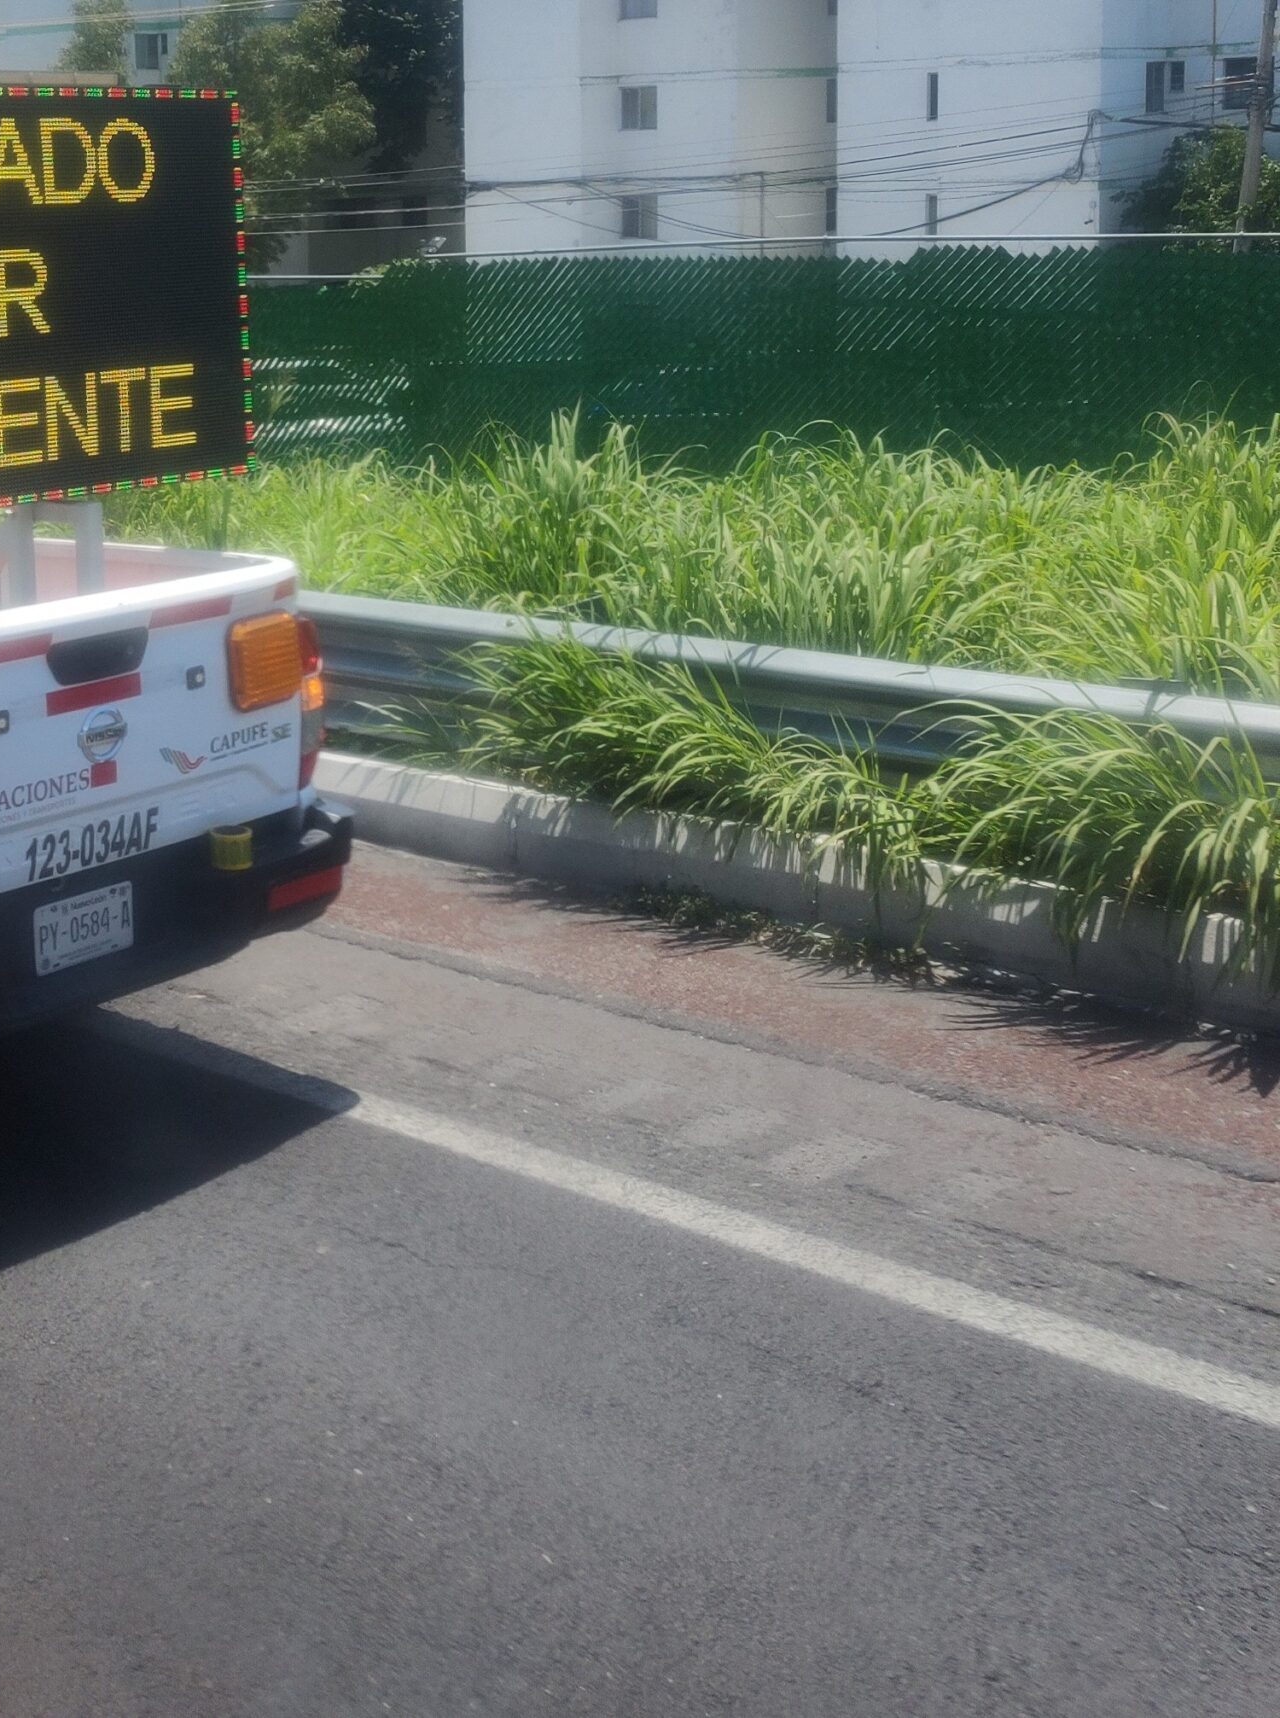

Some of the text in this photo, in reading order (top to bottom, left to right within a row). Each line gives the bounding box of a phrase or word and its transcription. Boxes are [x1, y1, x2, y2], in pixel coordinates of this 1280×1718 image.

[210, 721, 268, 754] CAPUFE
[25, 806, 159, 882] 123-034AF
[39, 900, 131, 955] PY-0584-A
